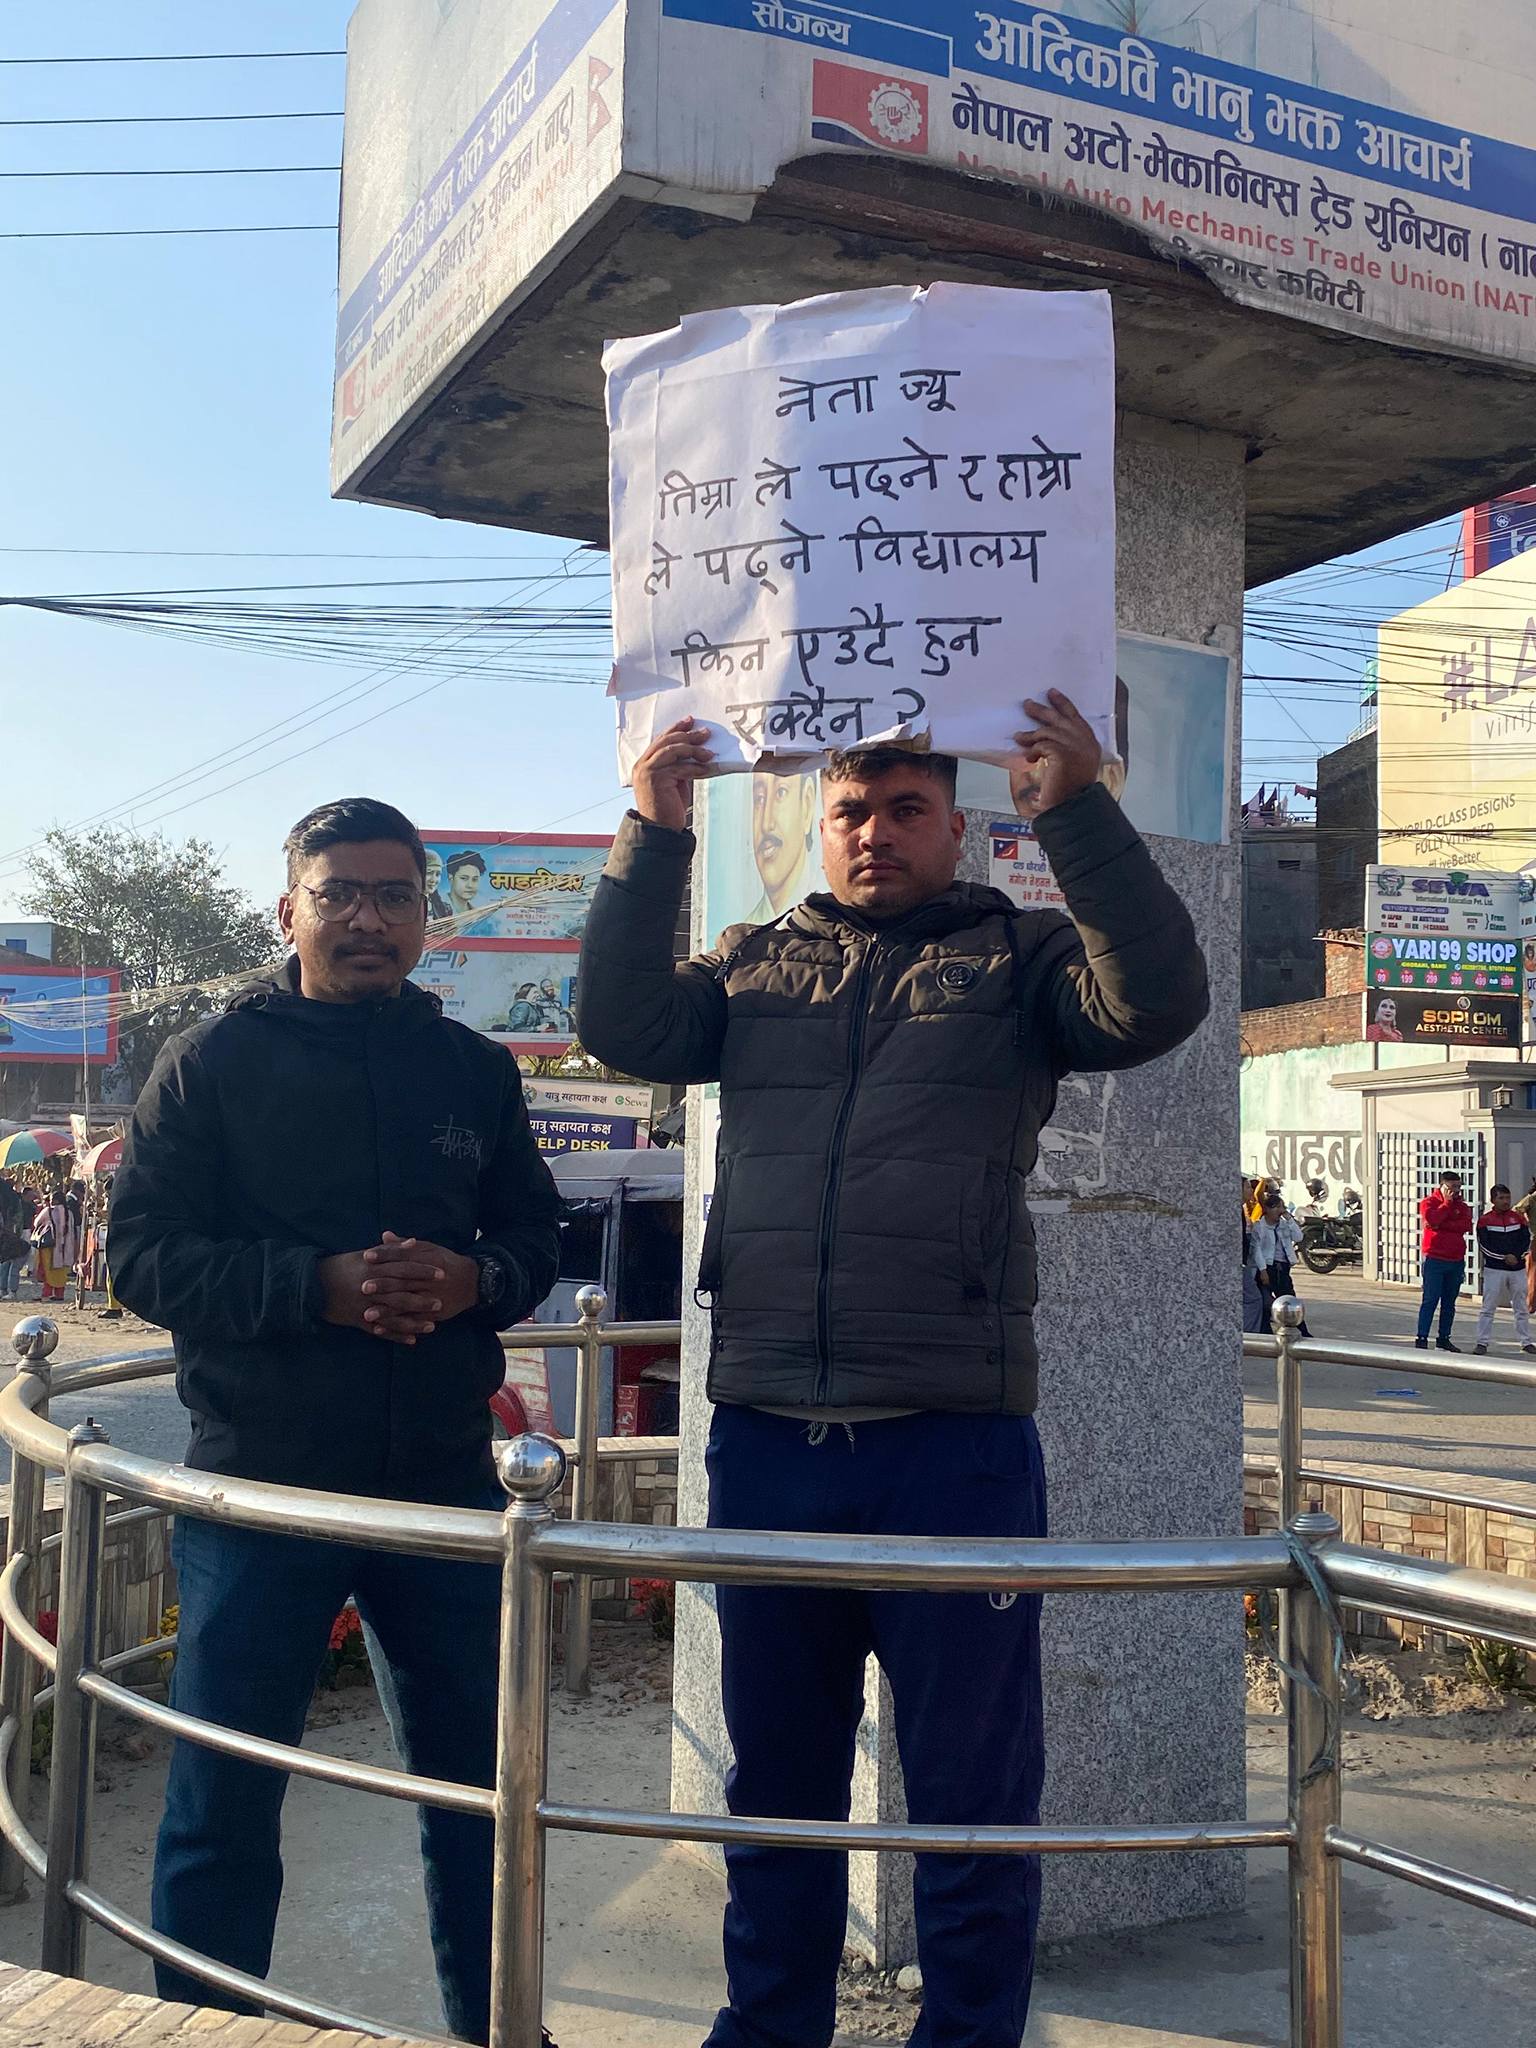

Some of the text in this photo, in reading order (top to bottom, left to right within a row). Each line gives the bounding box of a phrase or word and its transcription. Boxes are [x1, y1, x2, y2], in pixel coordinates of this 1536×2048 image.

[752, 0, 851, 46] सौजन्य
[488, 39, 539, 153] आचार्य
[975, 10, 1473, 190] आदिकवि भानु भक्त आचार्य
[951, 82, 1052, 153] नेपाल
[1310, 176, 1355, 236] ट्रेड
[1364, 197, 1471, 262] युनियन
[1142, 196, 1296, 256] Mechanics
[1303, 236, 1382, 282] Trade
[1390, 260, 1465, 301] Union
[1473, 280, 1536, 318] (NAT
[1276, 268, 1365, 313] कमिटी
[775, 374, 878, 422] नेता
[755, 457, 800, 506] ले
[644, 541, 681, 596] ले
[671, 631, 770, 687] किन
[781, 603, 904, 687] एउटै
[1470, 793, 1516, 819] DESIGNS
[1392, 938, 1517, 964] YARI 99 SHOP
[1416, 1024, 1508, 1035] AESTHETIC CENTER
[561, 1092, 591, 1103] सहायता
[535, 1137, 611, 1152] ELP DESK
[549, 1121, 590, 1133] सहायता
[591, 1123, 612, 1135] कक्ष
